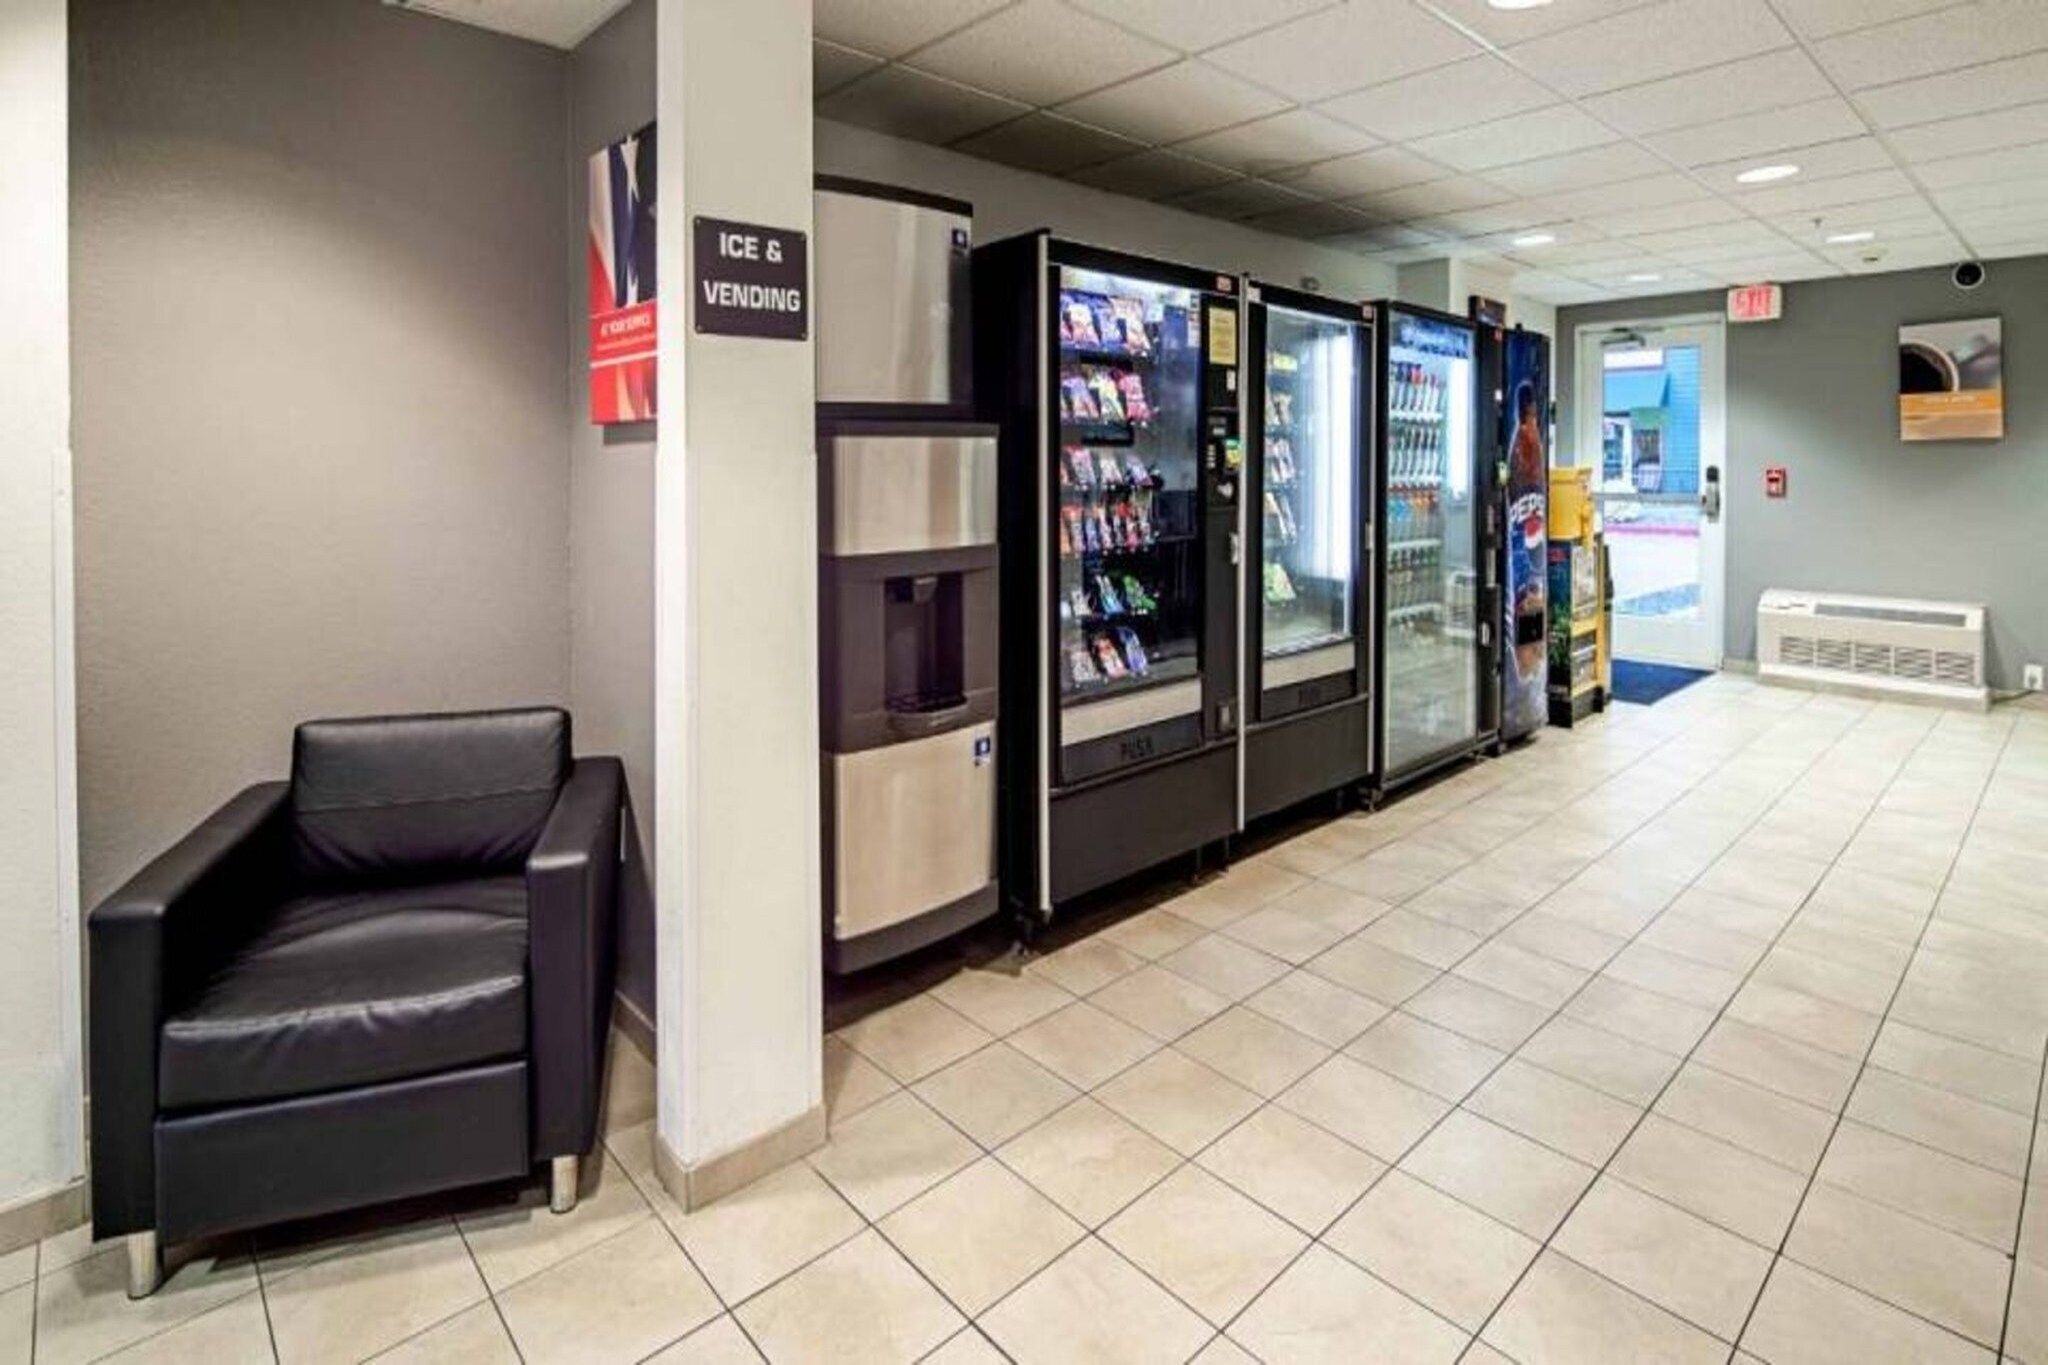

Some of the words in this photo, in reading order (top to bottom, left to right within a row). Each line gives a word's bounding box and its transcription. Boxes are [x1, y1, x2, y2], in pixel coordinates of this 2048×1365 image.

[720, 232, 759, 260] ICE
[766, 239, 783, 263] &
[703, 280, 801, 312] VENDING
[1509, 493, 1546, 523] PEPS
